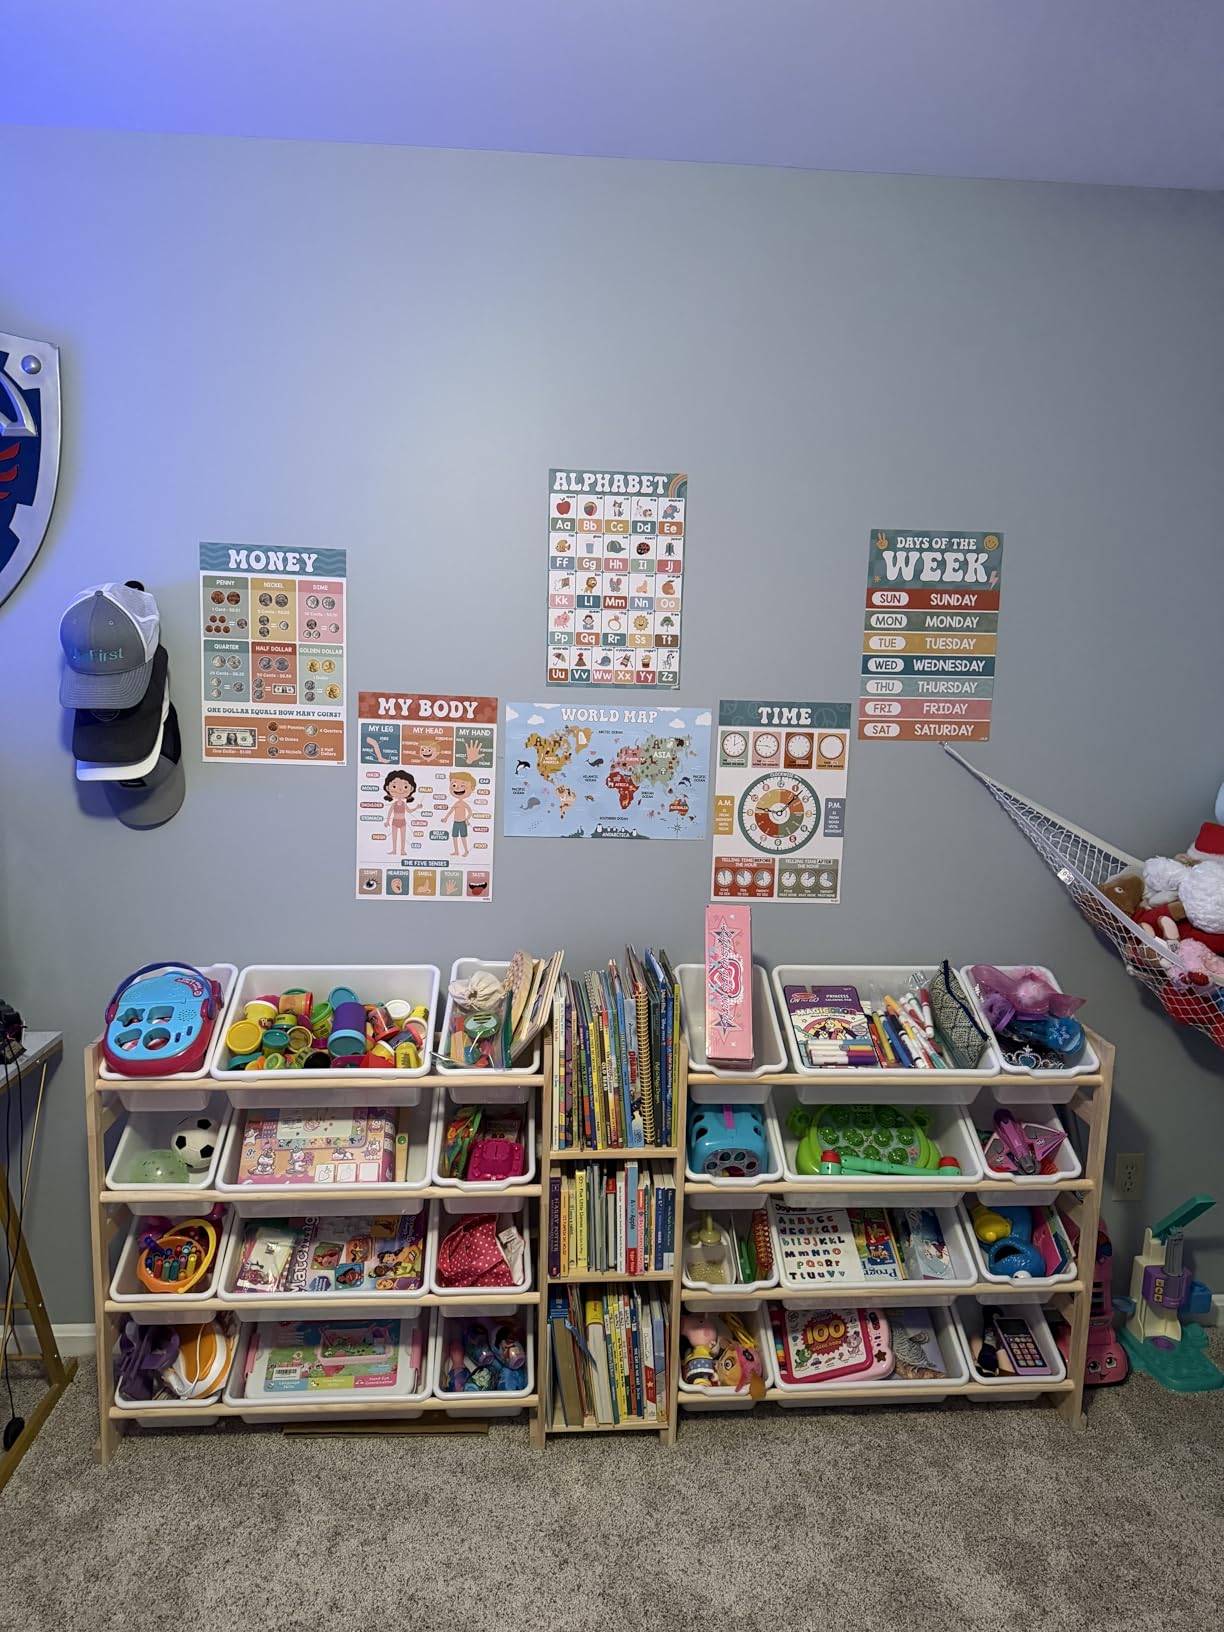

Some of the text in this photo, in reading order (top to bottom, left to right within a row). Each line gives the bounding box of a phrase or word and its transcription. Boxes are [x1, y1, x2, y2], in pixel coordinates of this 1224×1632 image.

[554, 472, 667, 494] ALPHABET
[556, 520, 570, 529] Aa
[584, 521, 597, 530] Bb
[610, 522, 623, 531] Cc
[637, 524, 651, 532] Dd
[664, 524, 677, 533] Ee
[897, 537, 976, 549] DAYS OF THE
[228, 550, 318, 572] MONEY
[557, 558, 568, 568] Ff
[583, 559, 596, 570] Gg
[609, 560, 622, 570] Hh
[638, 561, 646, 570] Ii
[665, 561, 674, 572] Jj
[882, 551, 988, 582] WEEK
[555, 594, 568, 605] Kk
[585, 596, 592, 606] Ll
[606, 598, 625, 606] Mm
[634, 599, 648, 607] Nn
[661, 600, 675, 608] Oo
[880, 594, 901, 604] SUN
[930, 594, 977, 606] SUNDAY
[875, 616, 902, 626] MON
[926, 616, 979, 628] MONDAY
[555, 633, 568, 642] Pp
[581, 634, 595, 644] Qq
[608, 635, 620, 643] Rr
[635, 636, 646, 644] Ss
[662, 636, 672, 644] Tt
[878, 638, 896, 648] TUE
[926, 638, 976, 650] TUESDAY
[90, 648, 124, 662] First
[875, 661, 897, 670] WED
[913, 659, 985, 672] WEDNESDAY
[618, 672, 630, 680] Xx
[640, 673, 652, 682] Yy
[875, 682, 894, 691] THU
[918, 681, 977, 693] THURSDAY
[378, 698, 478, 718] MY BODY
[874, 704, 892, 713] FRI
[923, 703, 968, 715] FRIDAY
[561, 709, 657, 723] WORLD MAP
[758, 707, 812, 725] TIME
[872, 725, 891, 734] SAT
[914, 725, 974, 736] SATURDAY
[806, 1321, 845, 1344] 100
